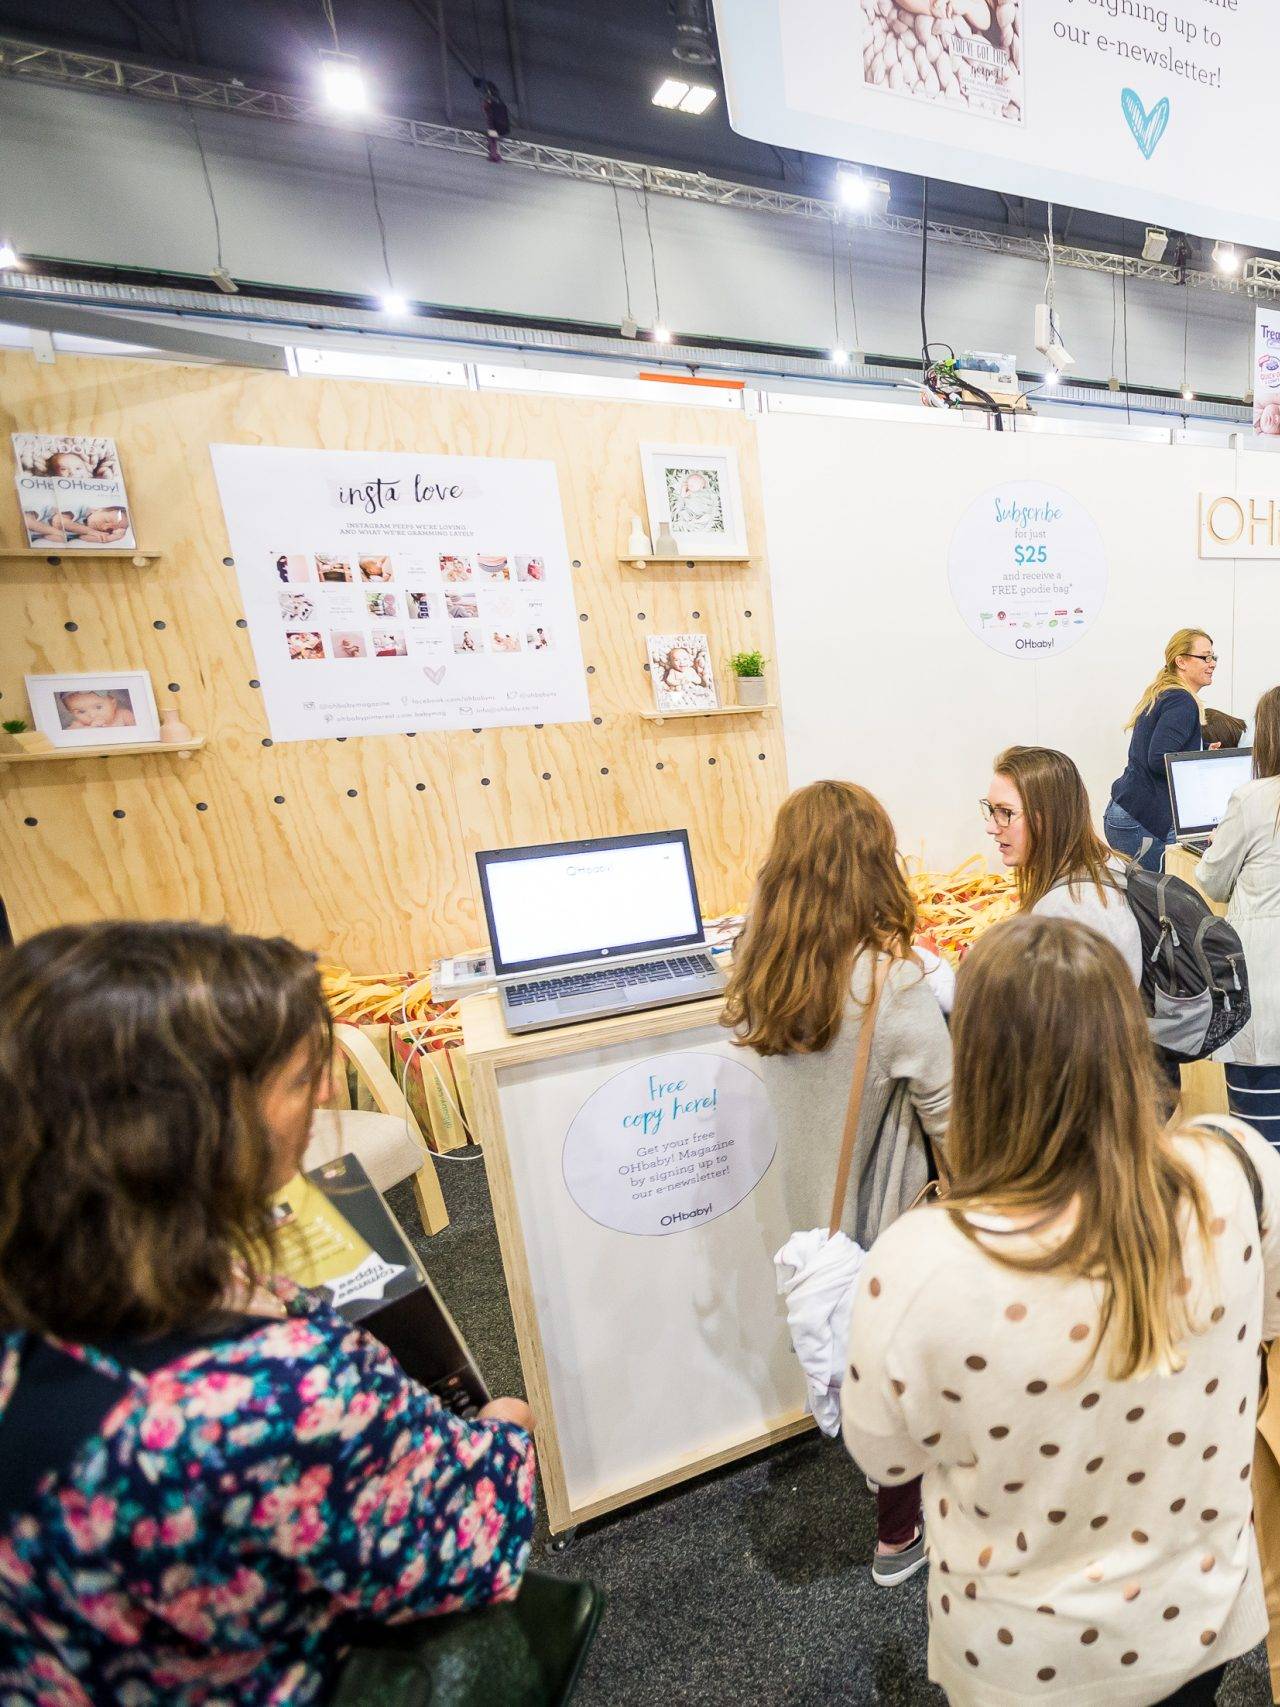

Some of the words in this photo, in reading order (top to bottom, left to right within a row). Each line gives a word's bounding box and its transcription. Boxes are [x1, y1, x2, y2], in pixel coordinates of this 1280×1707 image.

[1174, 16, 1197, 42] up
[1203, 25, 1221, 47] to
[1053, 21, 1090, 46] our
[1096, 34, 1221, 88] e-newsletter!
[58, 479, 119, 492] OHbaby!
[338, 478, 400, 514] insta
[415, 473, 463, 502] love
[995, 497, 1063, 528] Subscribe
[340, 528, 357, 536] AND
[346, 522, 391, 530] INSTAGRAM
[1014, 528, 1028, 539] for
[1028, 529, 1047, 541] just
[1014, 544, 1048, 566] $25
[1002, 569, 1021, 581] and
[1022, 571, 1054, 580] receive
[1056, 572, 1062, 580] a
[991, 584, 1018, 596] FREE
[1020, 584, 1051, 596] goodie
[1015, 637, 1055, 649] OHbaby!
[649, 1074, 688, 1101] Free
[622, 1108, 664, 1135] copy
[672, 1088, 718, 1120] here!
[618, 1155, 676, 1176] OHbaby!
[678, 1138, 735, 1161] Magazine
[636, 1144, 659, 1157] Get
[662, 1138, 689, 1153] your
[693, 1131, 715, 1143] free
[630, 1176, 645, 1187] by
[649, 1163, 695, 1183] signing
[698, 1160, 713, 1171] up
[716, 1153, 728, 1164] to
[632, 1189, 652, 1200] our
[656, 1165, 731, 1194] e-newsletter!
[660, 1202, 712, 1227] OHbaby!
